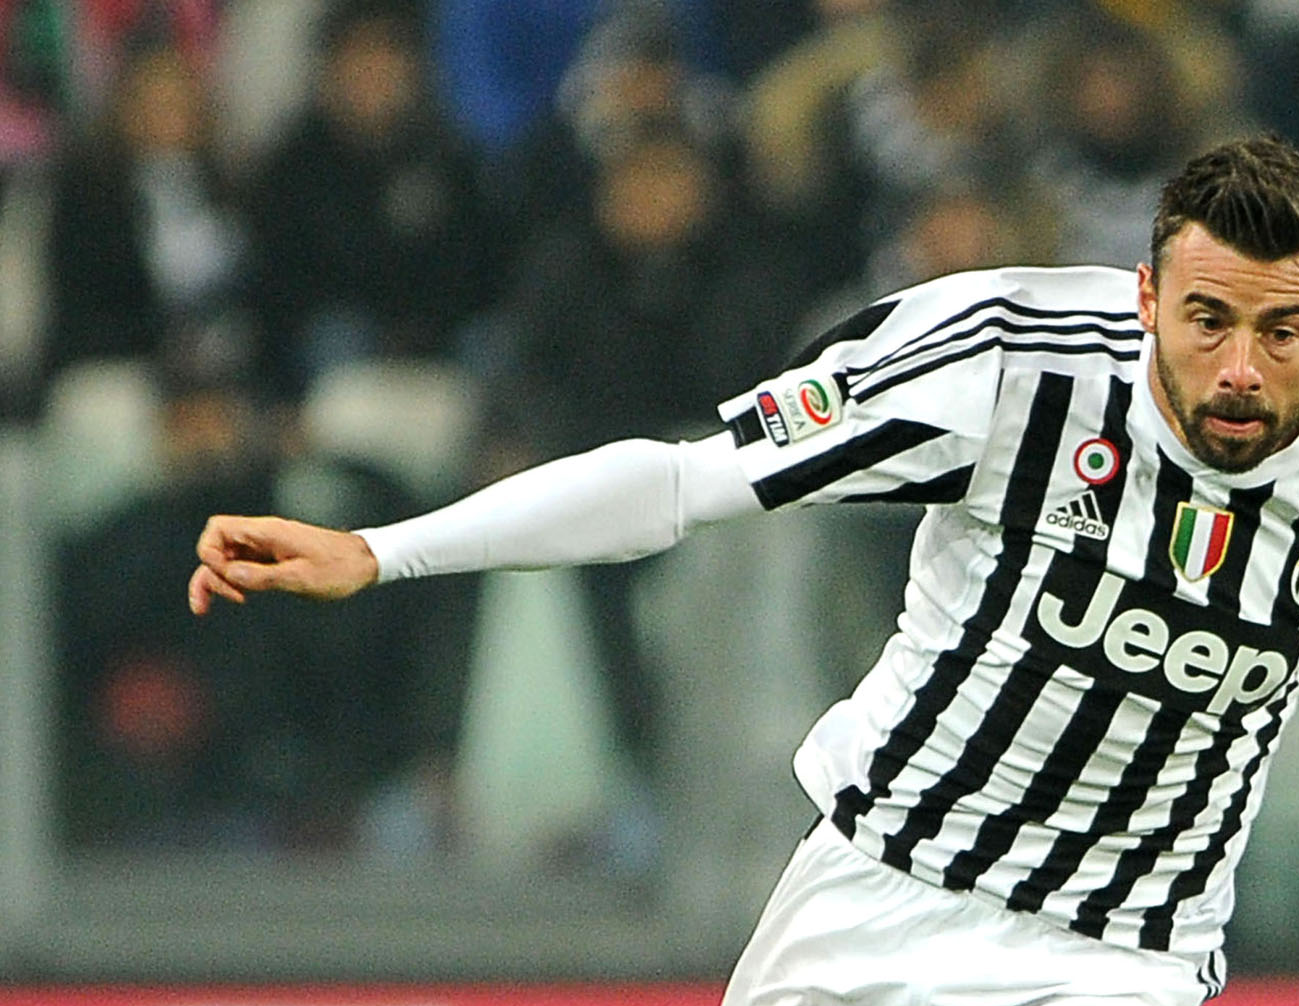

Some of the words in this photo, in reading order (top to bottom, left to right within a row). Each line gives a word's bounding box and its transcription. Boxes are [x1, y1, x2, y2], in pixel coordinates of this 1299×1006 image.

[766, 413, 789, 442] TIM
[1046, 513, 1106, 537] adidas
[1036, 571, 1289, 716] Jeep
